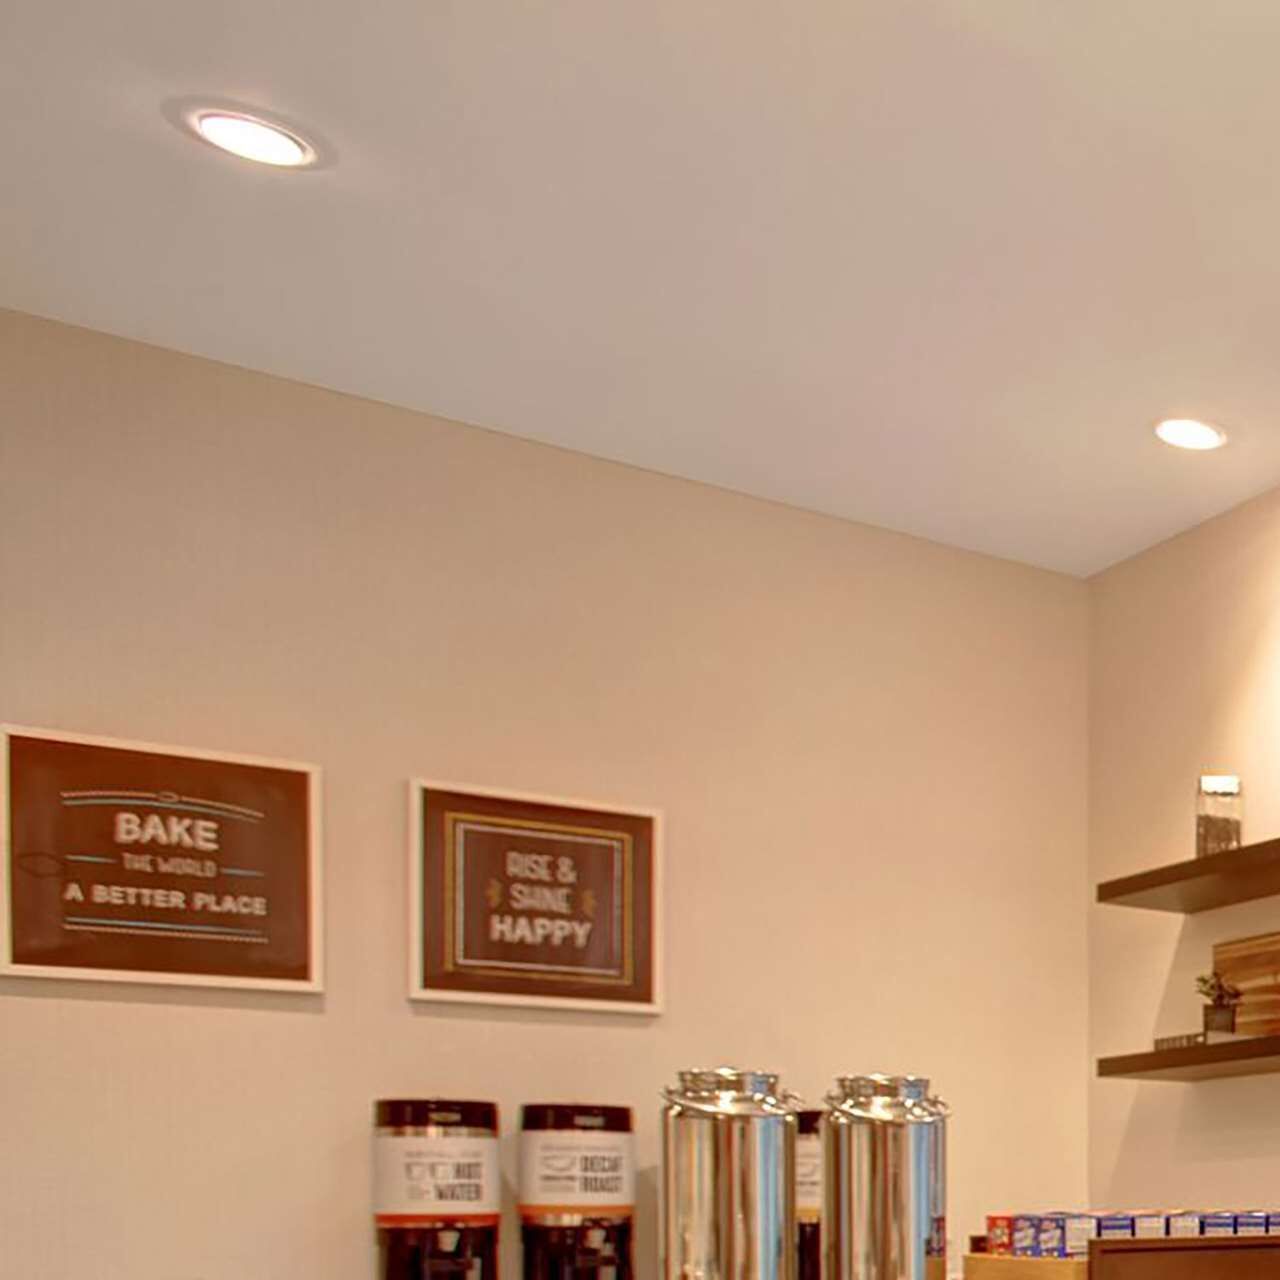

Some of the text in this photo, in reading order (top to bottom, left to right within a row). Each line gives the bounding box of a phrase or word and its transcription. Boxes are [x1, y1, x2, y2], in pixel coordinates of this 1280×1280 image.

[114, 812, 220, 851] BAKE
[122, 852, 217, 878] THE WORLD
[505, 851, 578, 885] RISE &
[64, 882, 268, 916] A BETTER PLACE
[509, 883, 572, 915] SHINE
[489, 914, 593, 949] HAPPY
